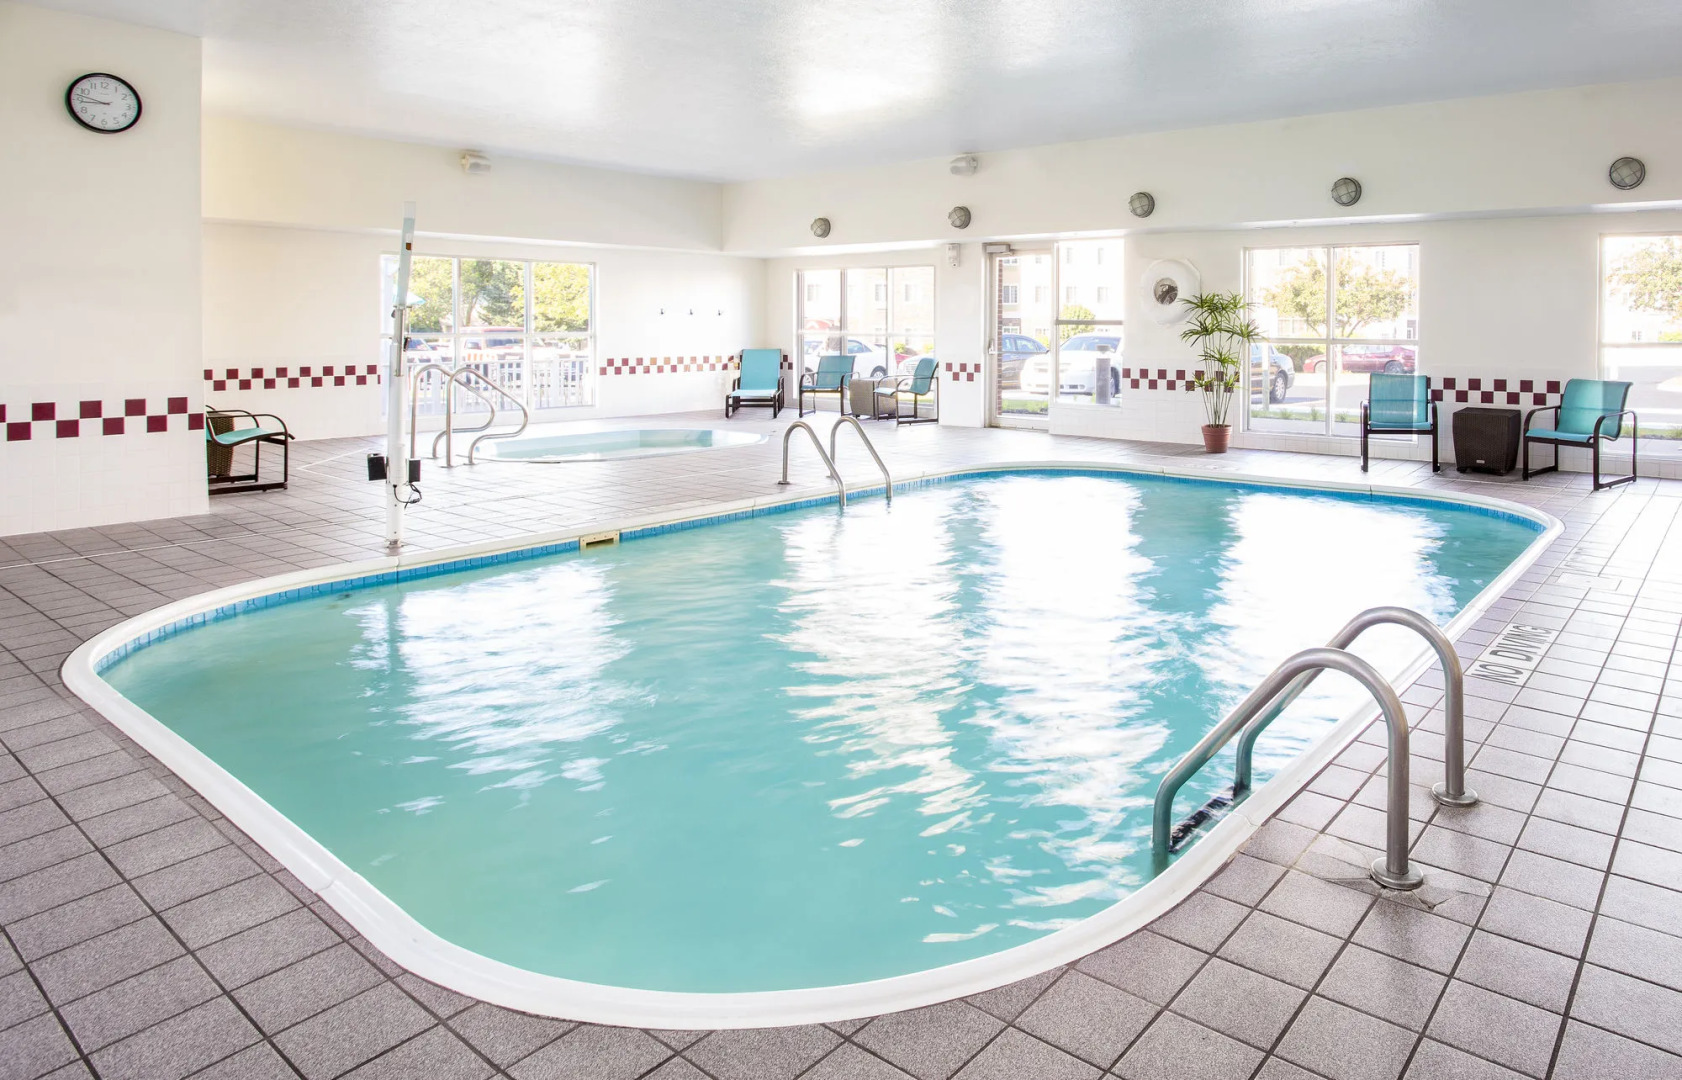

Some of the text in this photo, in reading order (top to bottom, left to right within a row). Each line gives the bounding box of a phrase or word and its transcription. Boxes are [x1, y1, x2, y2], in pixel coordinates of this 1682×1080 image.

[100, 82, 109, 90] 12
[1471, 625, 1552, 684] NO DIVING
